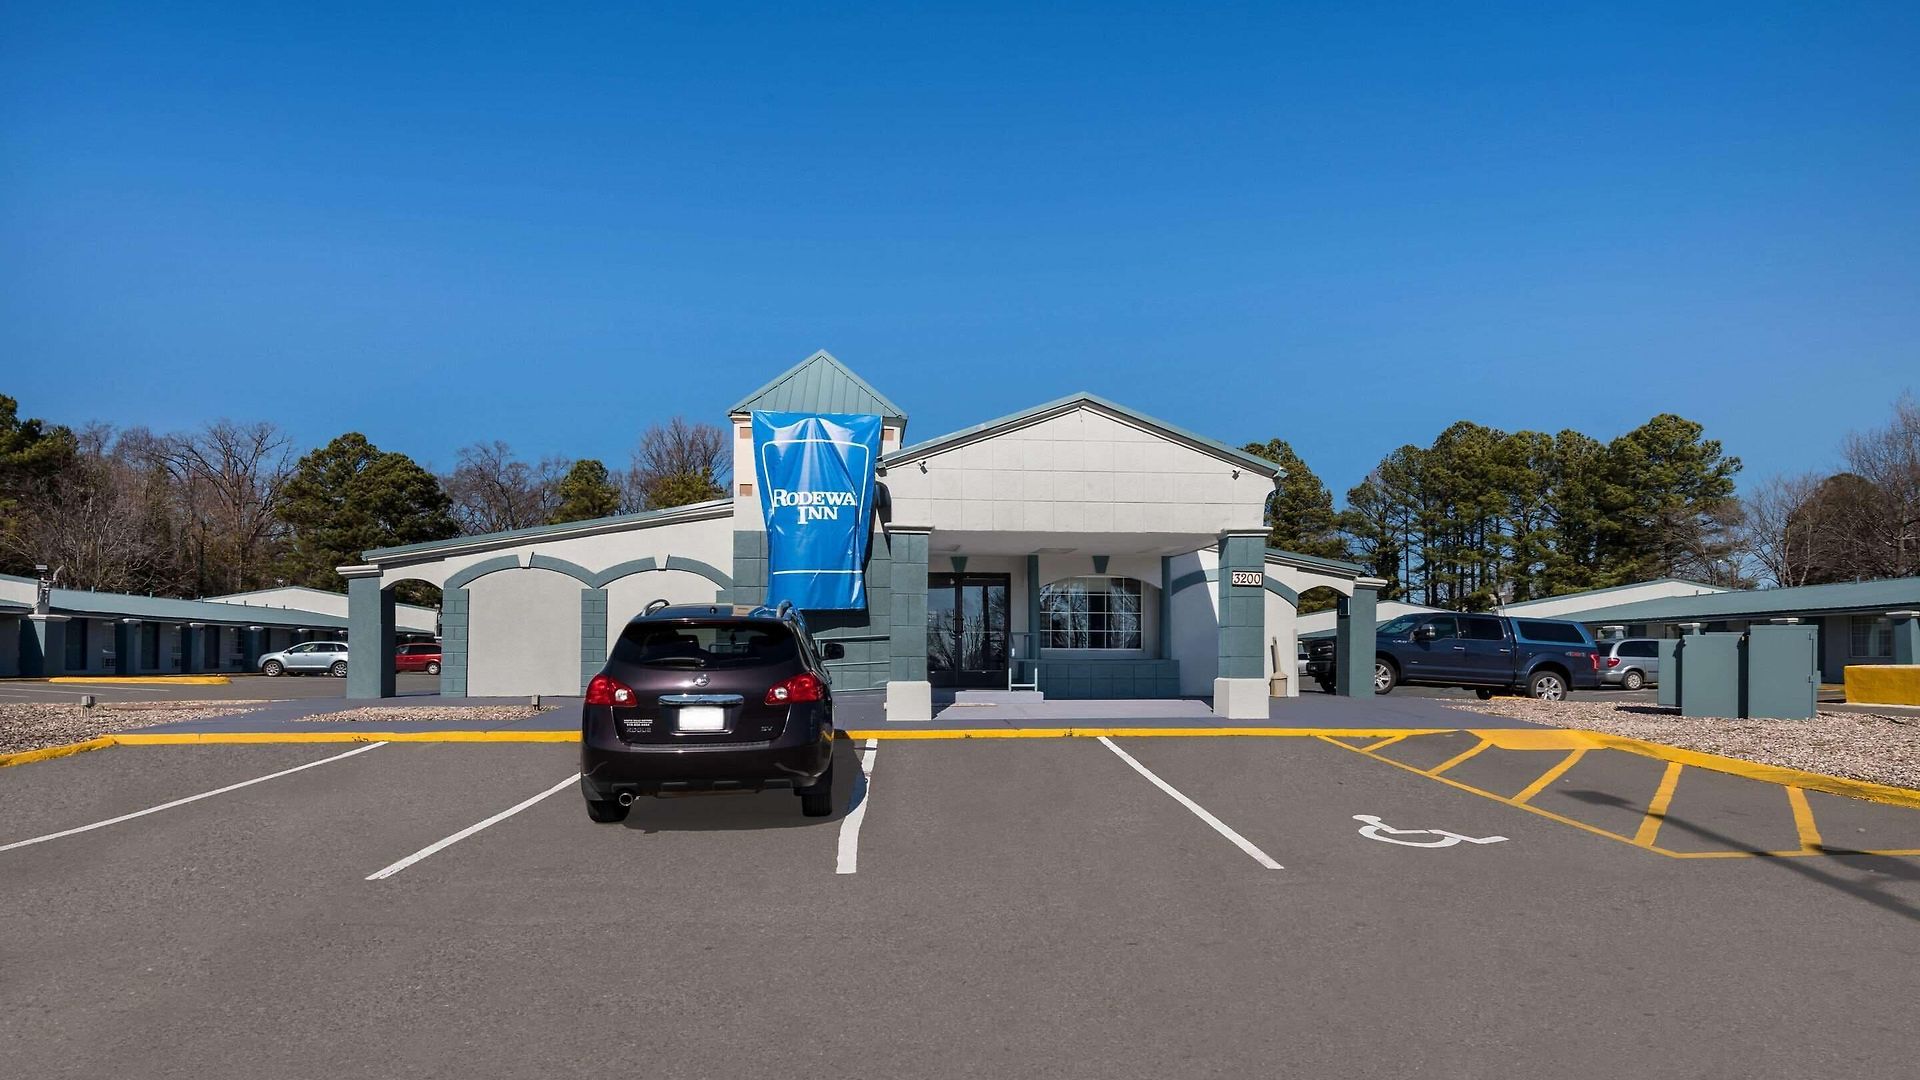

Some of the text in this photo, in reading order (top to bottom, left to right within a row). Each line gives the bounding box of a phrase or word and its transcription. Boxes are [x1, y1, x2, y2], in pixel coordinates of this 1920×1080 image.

[773, 489, 858, 507] RODEWA
[797, 506, 838, 525] INN
[1233, 573, 1261, 584] 3200
